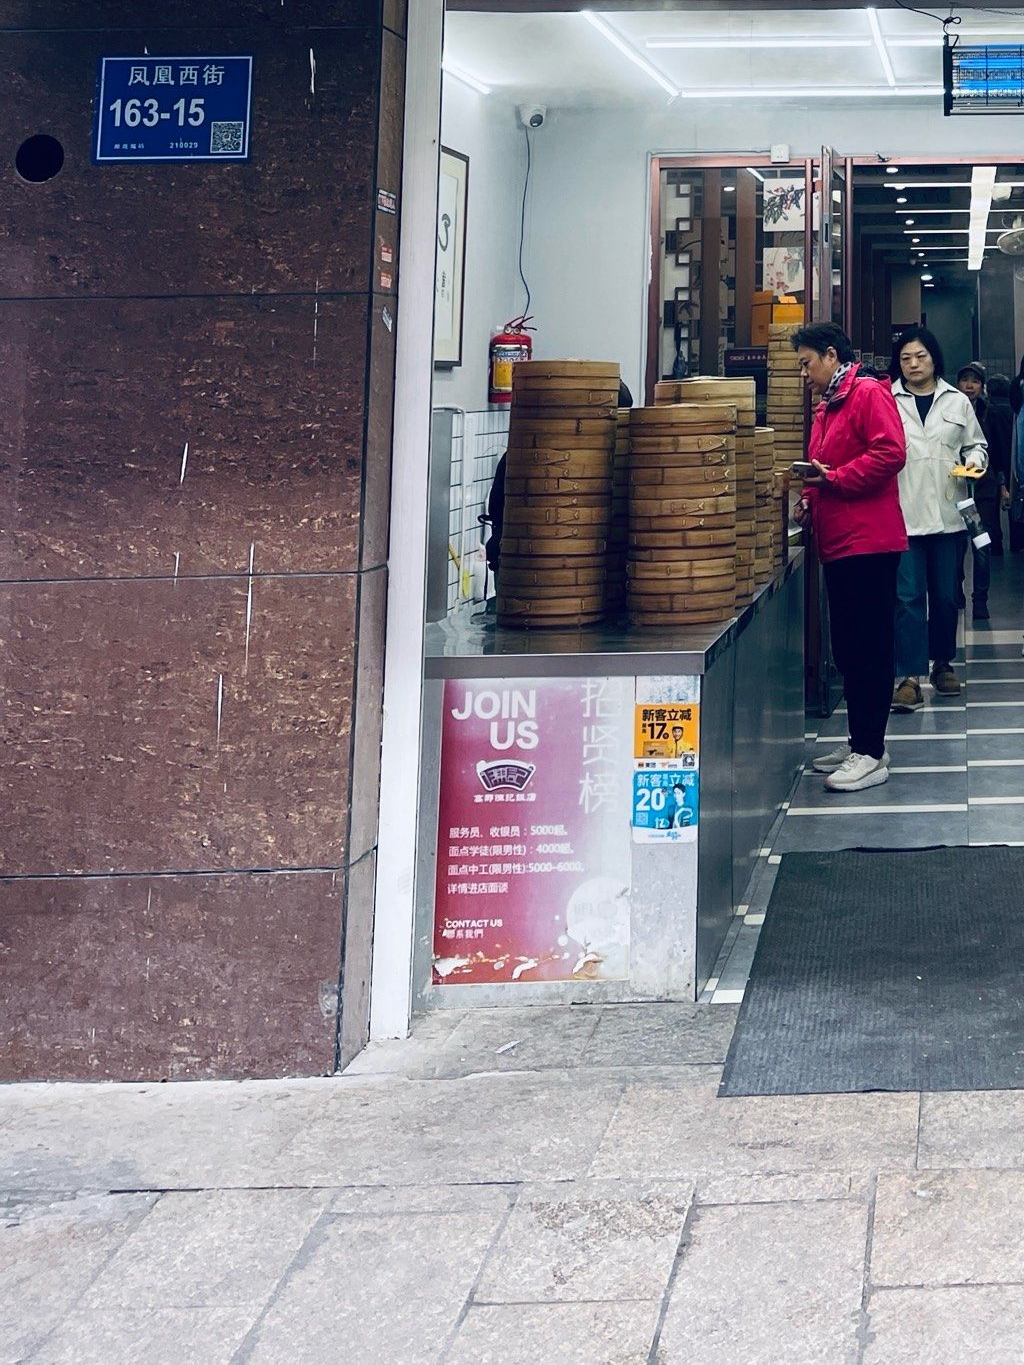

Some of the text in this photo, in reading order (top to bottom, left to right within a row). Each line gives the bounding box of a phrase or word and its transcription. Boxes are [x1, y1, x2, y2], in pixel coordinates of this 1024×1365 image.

[128, 64, 225, 86] 凤凰西街
[109, 98, 205, 127] 163-15
[169, 141, 199, 149] 210029
[451, 690, 536, 720] JOIN
[642, 708, 692, 721] 新客立减
[490, 721, 540, 750] US
[647, 722, 667, 739] 17
[636, 787, 666, 811] 20
[446, 919, 503, 929] CONTACT US
